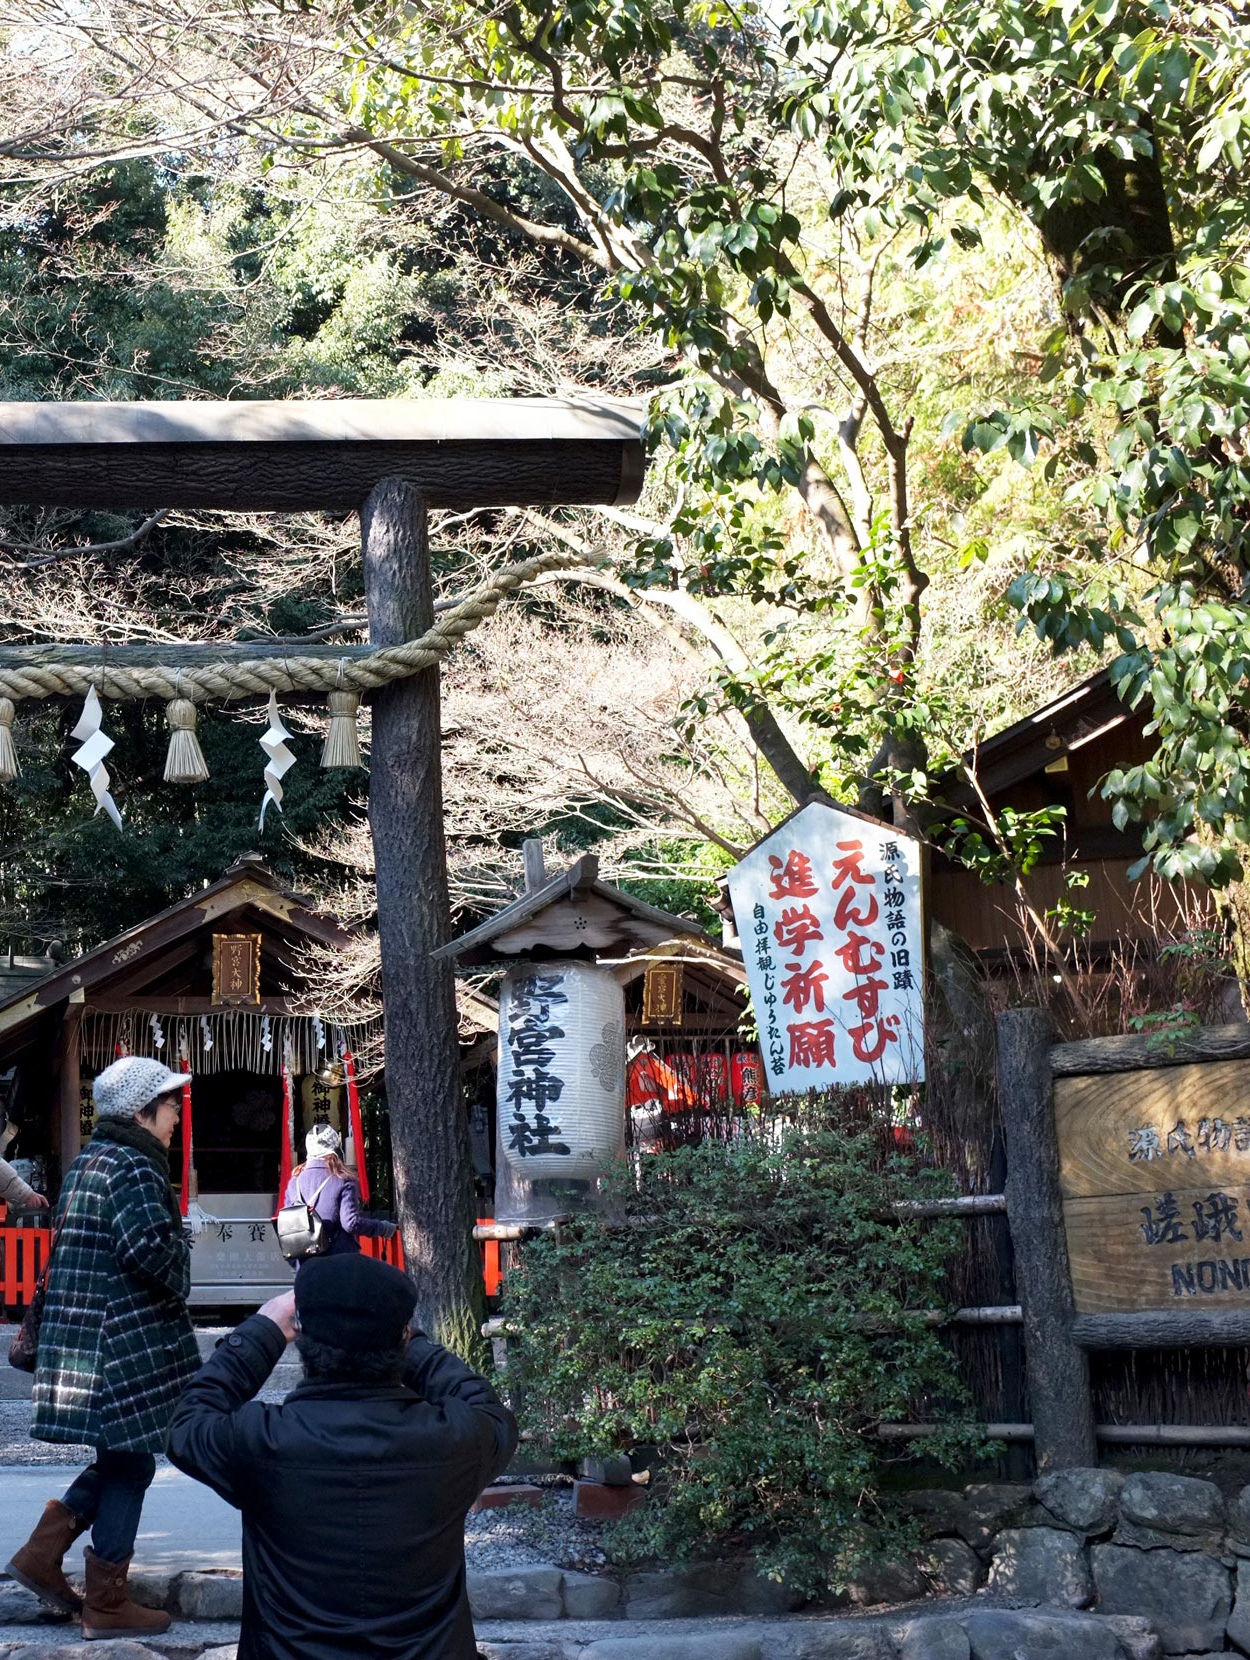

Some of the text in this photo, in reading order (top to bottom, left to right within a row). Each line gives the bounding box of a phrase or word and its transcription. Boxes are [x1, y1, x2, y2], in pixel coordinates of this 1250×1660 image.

[768, 849, 837, 1070] 進学祈願
[832, 839, 901, 1063] えんむすび
[879, 841, 914, 990] 源氏物語の旧蹟
[506, 974, 571, 1157] 野宮神社
[1139, 1191, 1250, 1246] 嵯峨
